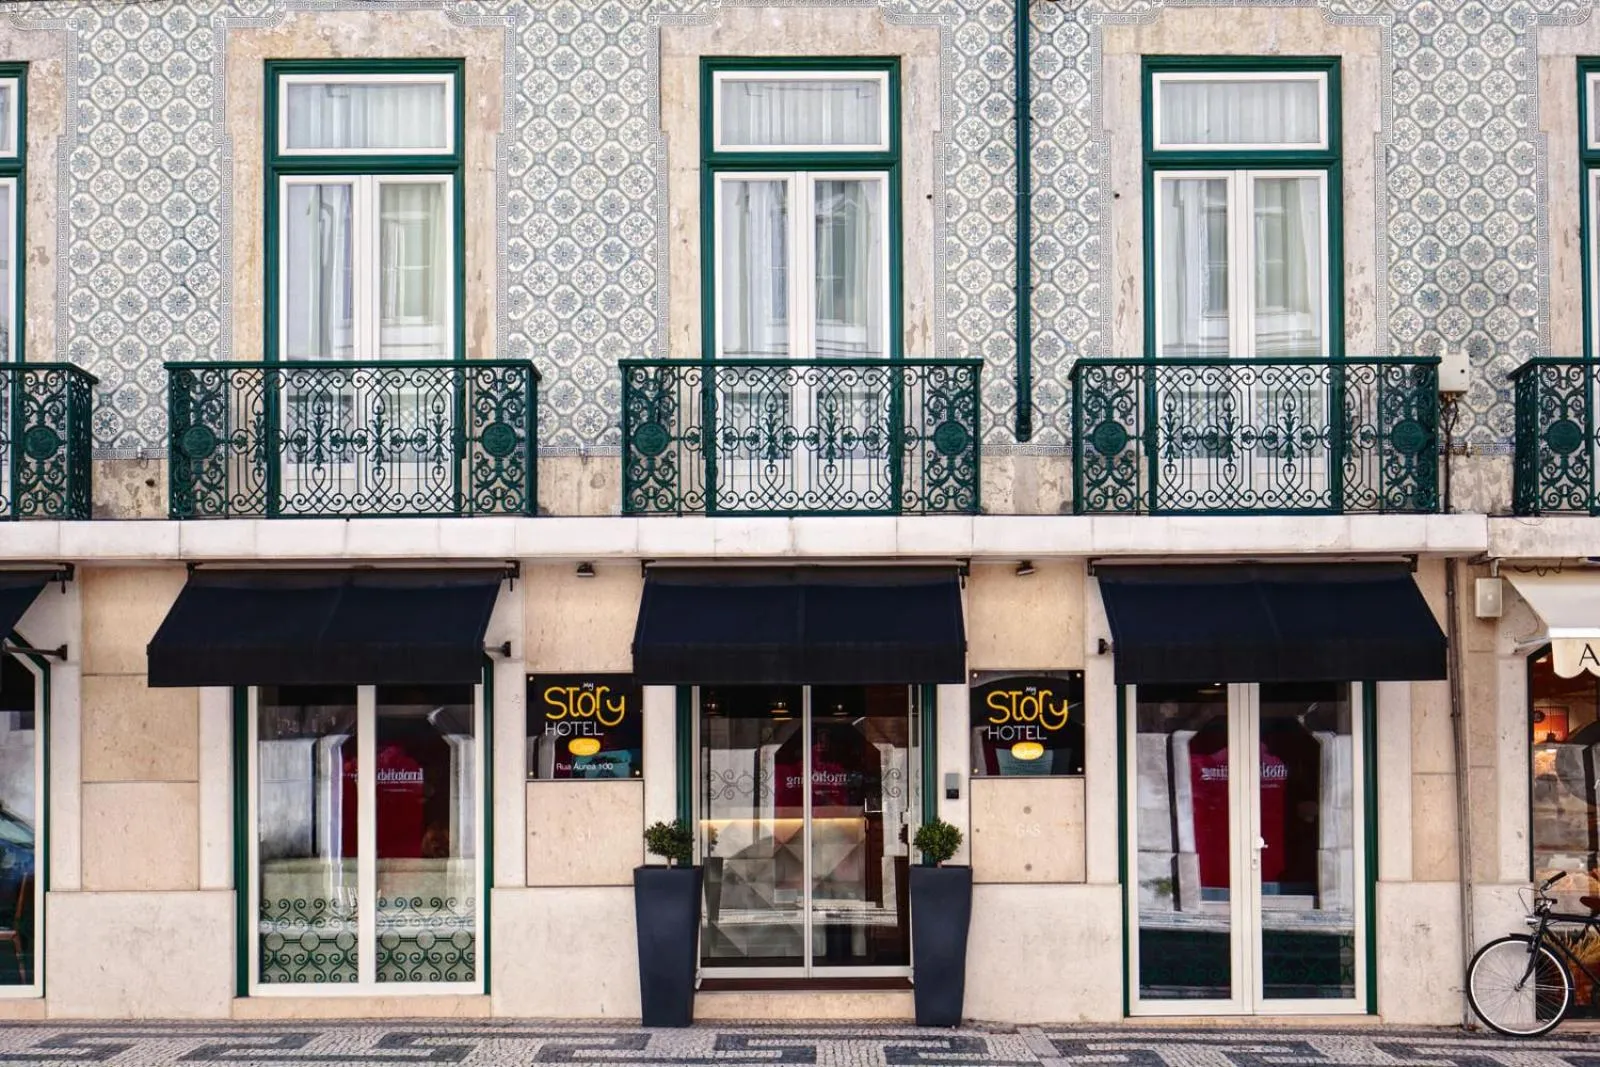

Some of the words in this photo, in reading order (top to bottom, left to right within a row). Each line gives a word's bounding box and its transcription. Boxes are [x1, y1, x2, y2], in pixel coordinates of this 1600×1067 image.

[545, 721, 604, 736] HOTEL
[988, 725, 1047, 741] HOTEL
[556, 762, 572, 771] Rua
[598, 762, 614, 771] 100
